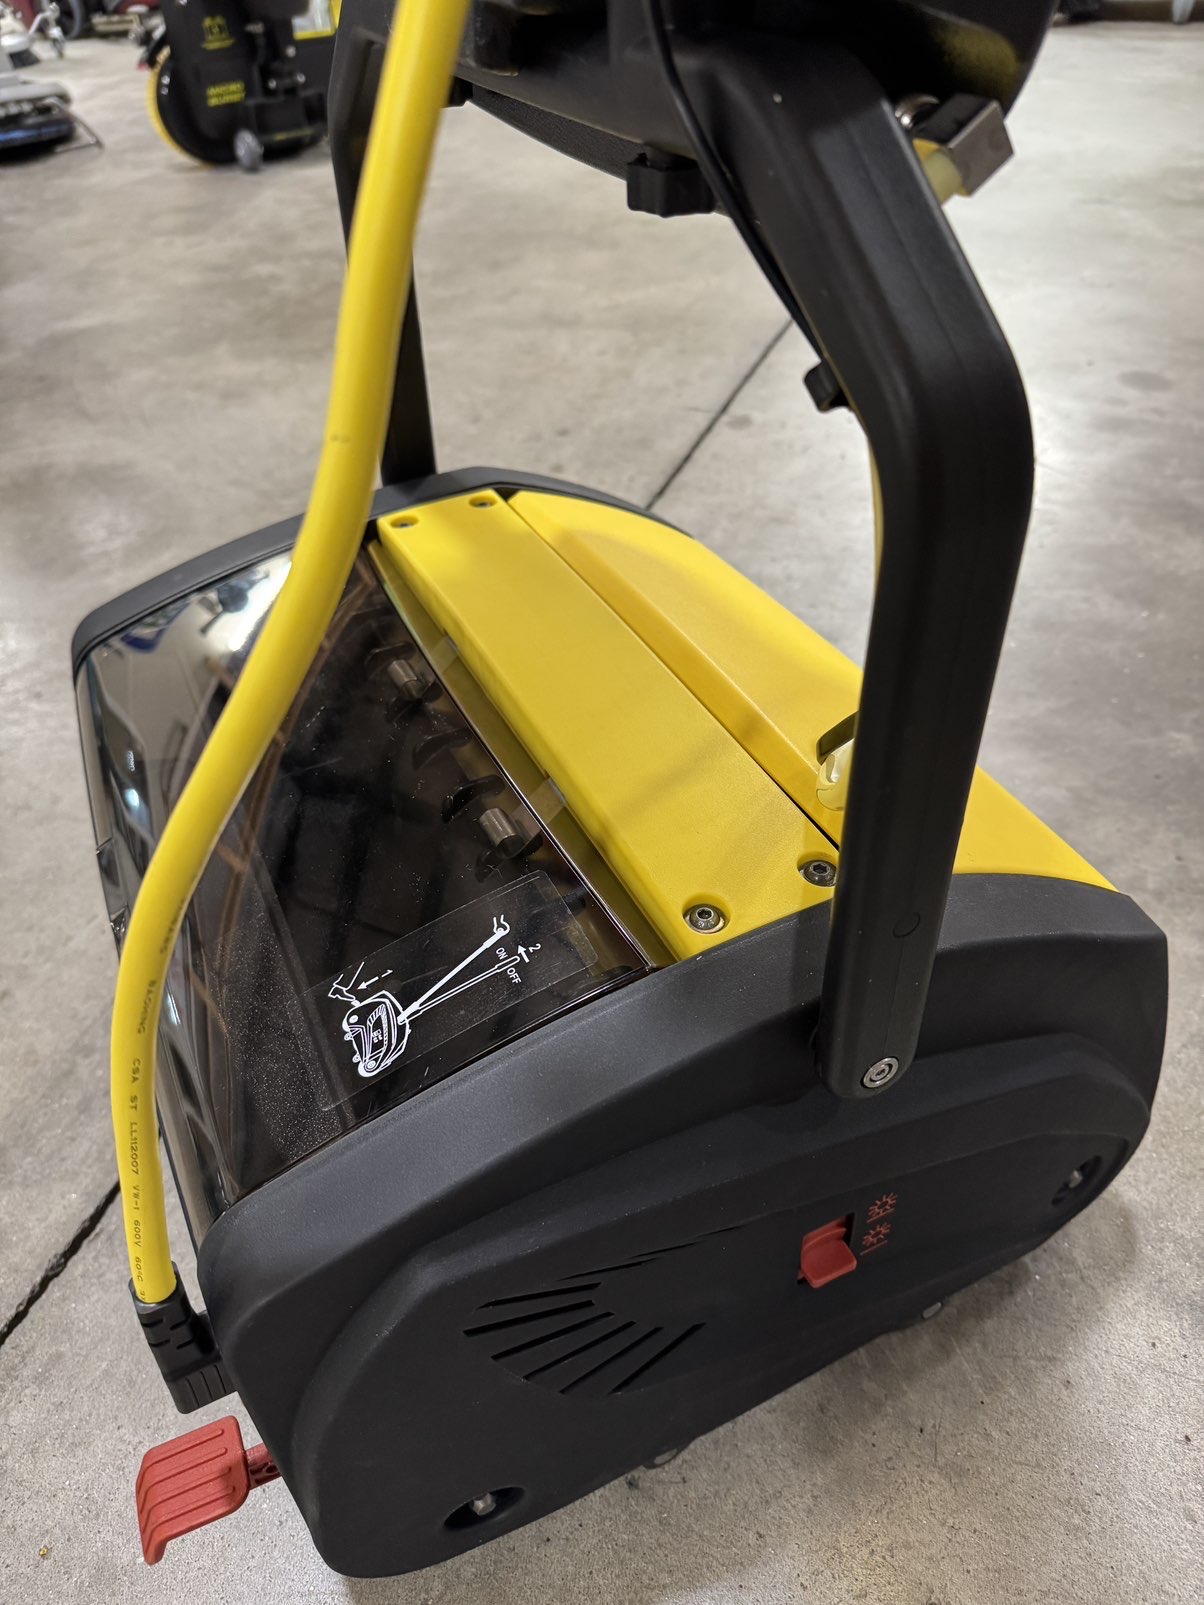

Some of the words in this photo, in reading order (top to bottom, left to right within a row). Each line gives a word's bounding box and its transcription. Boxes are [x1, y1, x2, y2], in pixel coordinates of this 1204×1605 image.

[495, 947, 508, 960] ON
[528, 943, 542, 953] 2
[381, 969, 394, 978] 1
[506, 967, 522, 984] OFF
[131, 1058, 141, 1084] CSA
[129, 1095, 139, 1111] ST
[129, 1121, 140, 1176] LL112007
[133, 1219, 142, 1248] 600V
